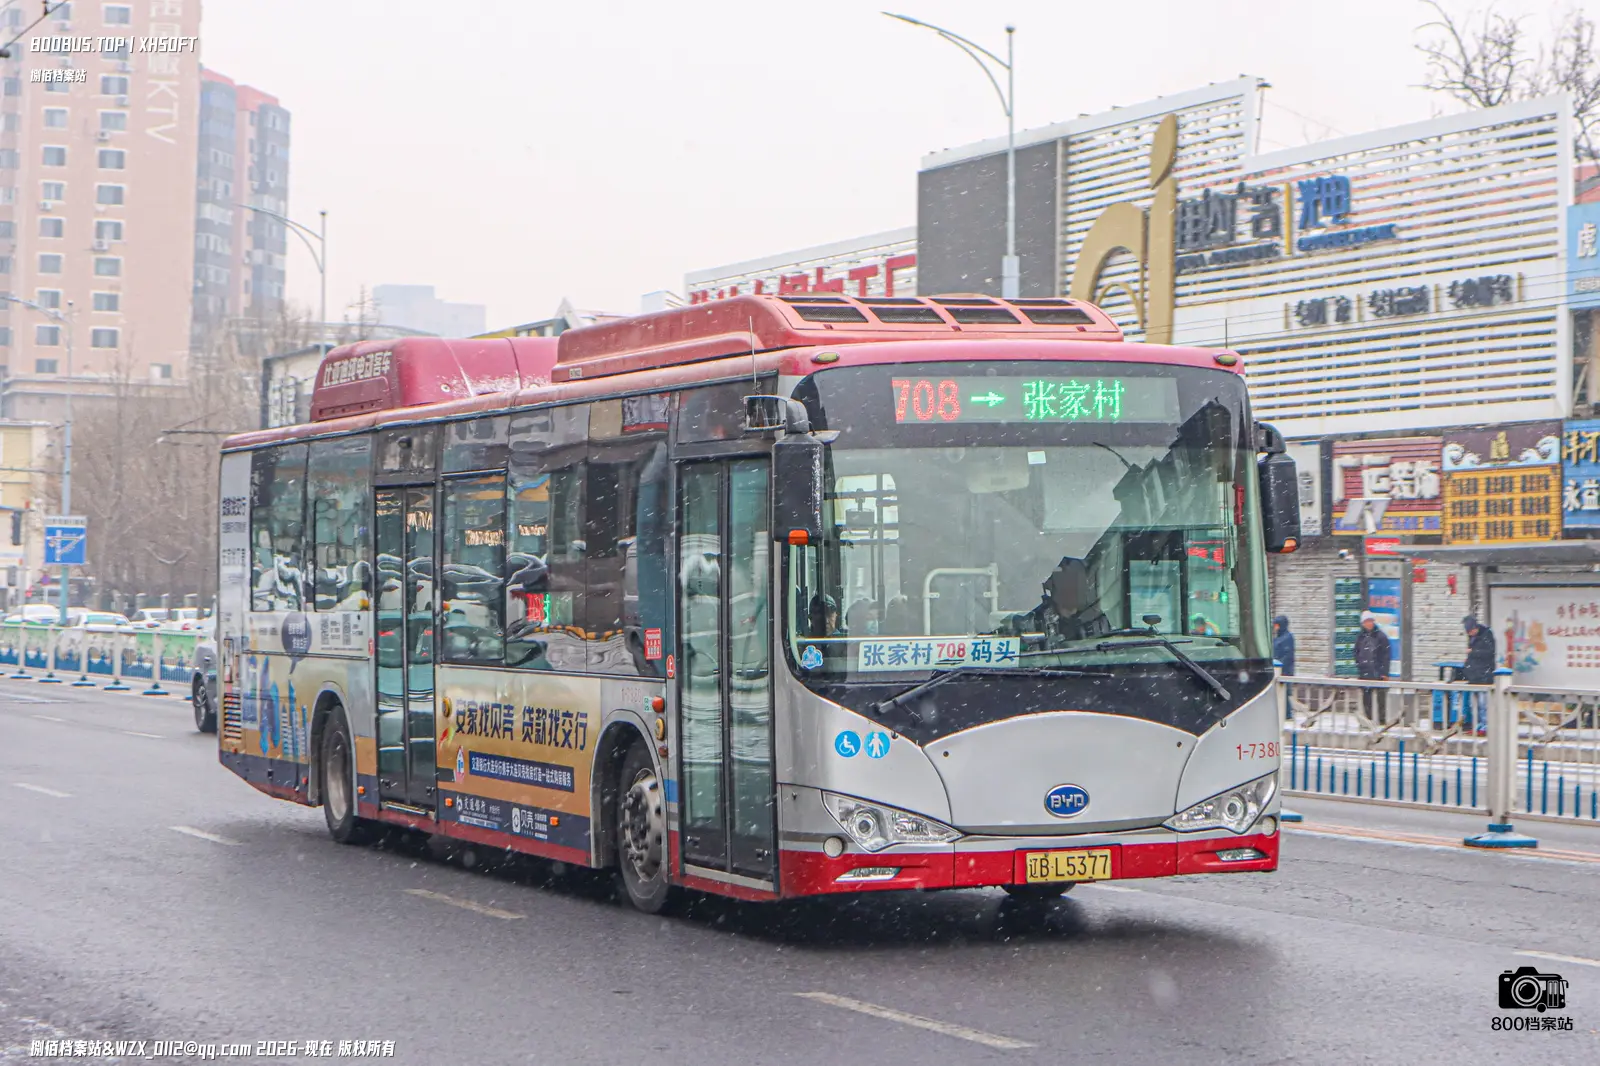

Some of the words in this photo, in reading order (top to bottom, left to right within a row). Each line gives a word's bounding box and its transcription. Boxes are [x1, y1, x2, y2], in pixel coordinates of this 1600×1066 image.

[892, 379, 961, 422] 708
[1022, 379, 1125, 420] 张家村
[863, 642, 933, 666] 张家村
[936, 642, 966, 659] 708
[971, 640, 1016, 663] 码头
[455, 698, 515, 741] 安家找贝壳
[522, 705, 589, 751] 贷款找交行
[1236, 742, 1280, 760] 1-7380
[1050, 794, 1084, 808] BYD
